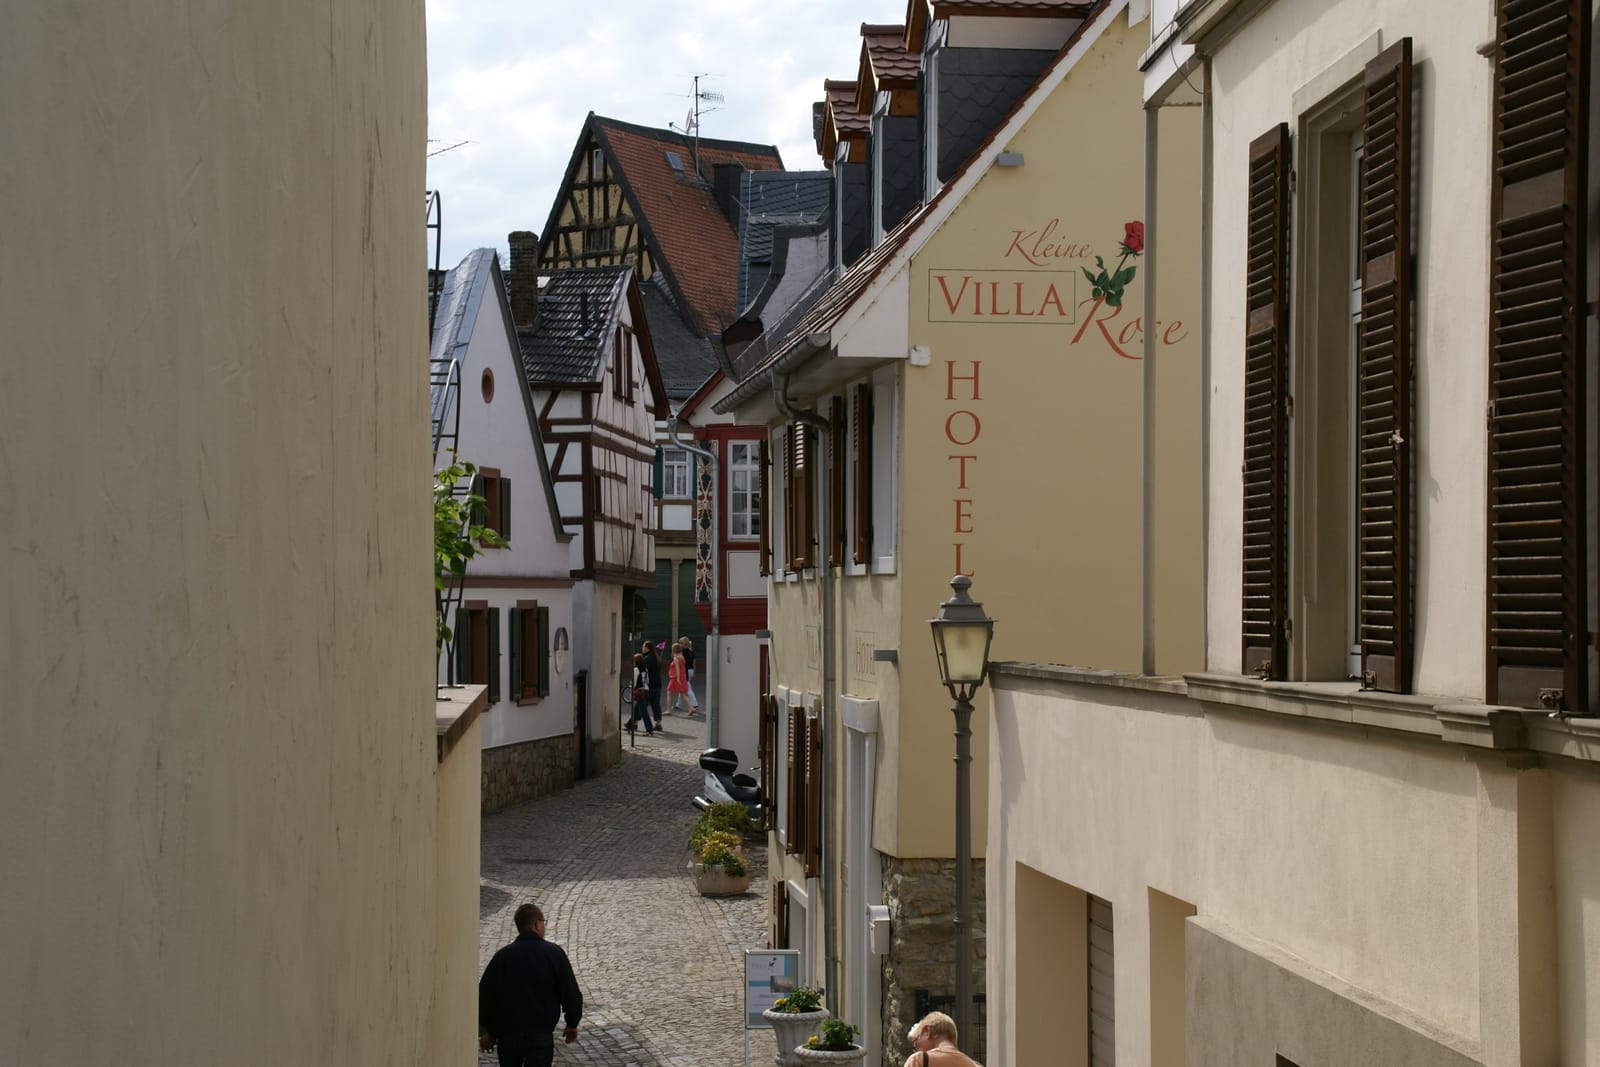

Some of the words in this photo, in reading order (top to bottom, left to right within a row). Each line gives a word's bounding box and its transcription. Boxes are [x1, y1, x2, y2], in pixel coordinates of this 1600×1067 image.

[1005, 218, 1094, 266] Kleine
[934, 275, 1067, 316] VILLA
[944, 360, 983, 577] HOTEL
